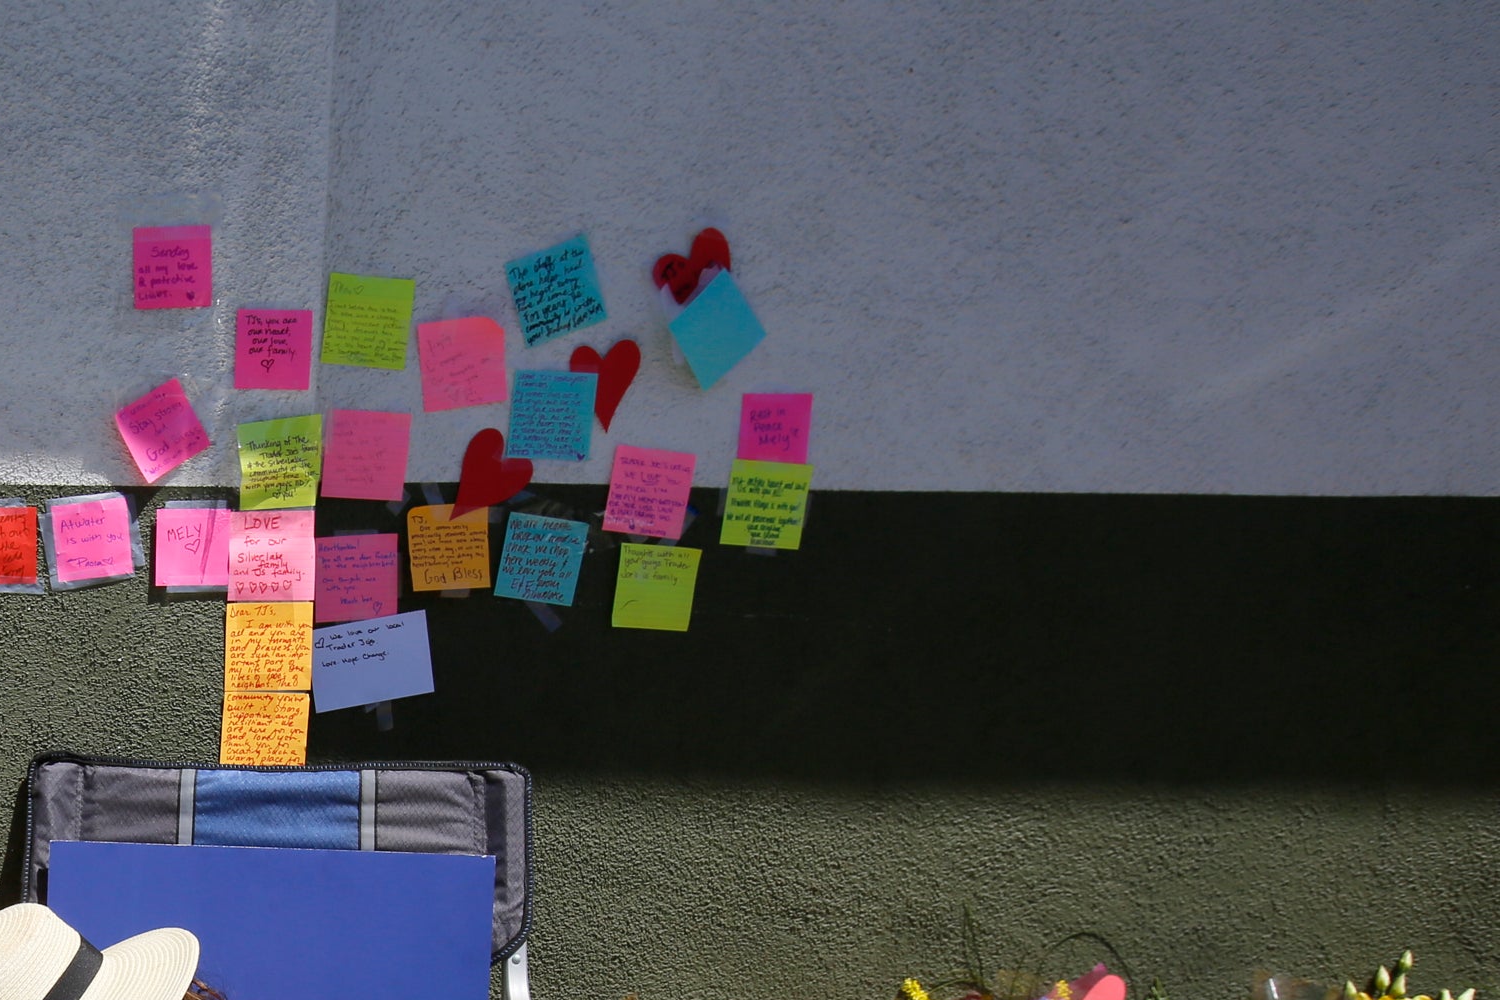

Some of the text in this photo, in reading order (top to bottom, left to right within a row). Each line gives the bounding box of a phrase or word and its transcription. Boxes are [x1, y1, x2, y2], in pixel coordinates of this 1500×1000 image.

[146, 440, 170, 461] God
[60, 516, 105, 533] Atwater
[244, 515, 281, 530] LOVE
[81, 534, 102, 543] with
[106, 533, 124, 543] you
[167, 523, 201, 542] MELY
[244, 536, 287, 547] for our
[233, 568, 249, 576] and
[258, 560, 288, 574] family
[424, 567, 483, 584] God Bless
[276, 620, 294, 628] with
[270, 630, 286, 641] you
[229, 641, 249, 652] and
[325, 641, 355, 651] Trader
[264, 659, 283, 668] part
[267, 664, 283, 672] and
